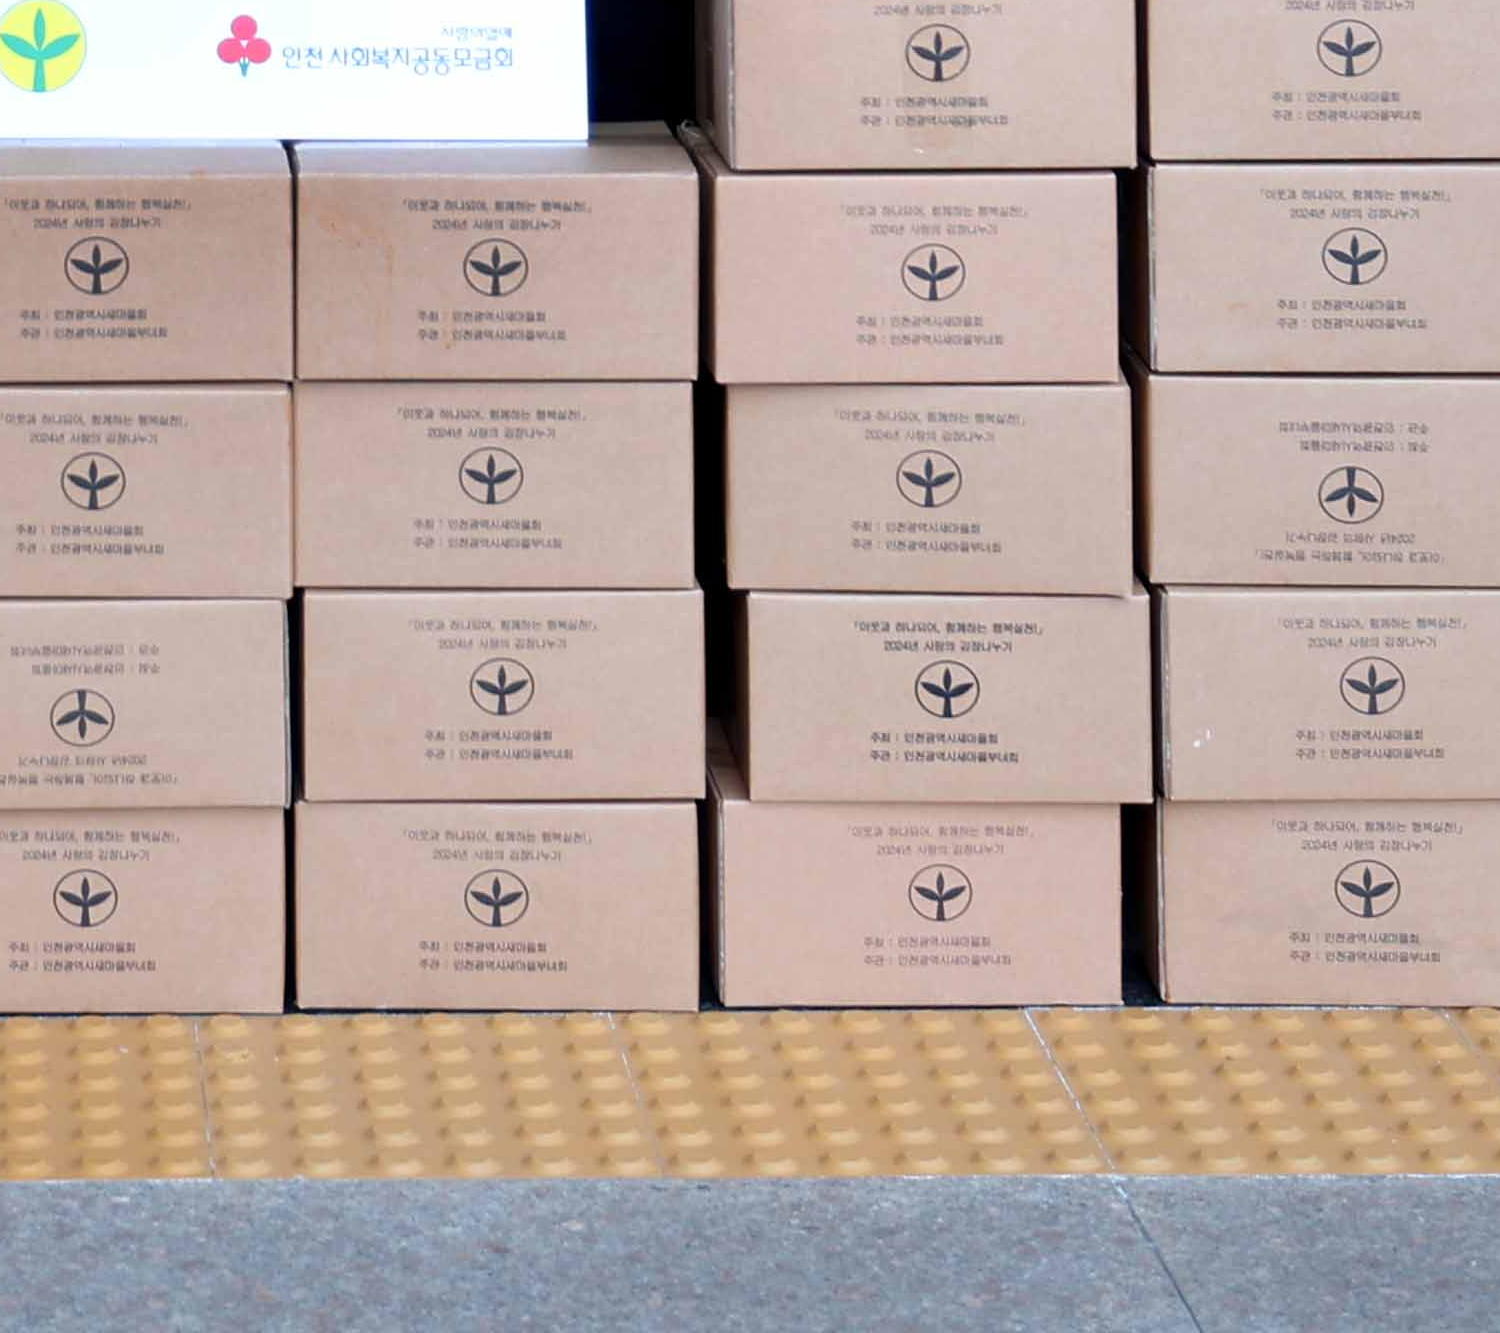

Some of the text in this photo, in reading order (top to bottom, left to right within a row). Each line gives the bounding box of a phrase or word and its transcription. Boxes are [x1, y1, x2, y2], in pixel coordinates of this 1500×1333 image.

[281, 45, 514, 76] 인천 사회복지공동모금회
[883, 640, 920, 652] 2024년
